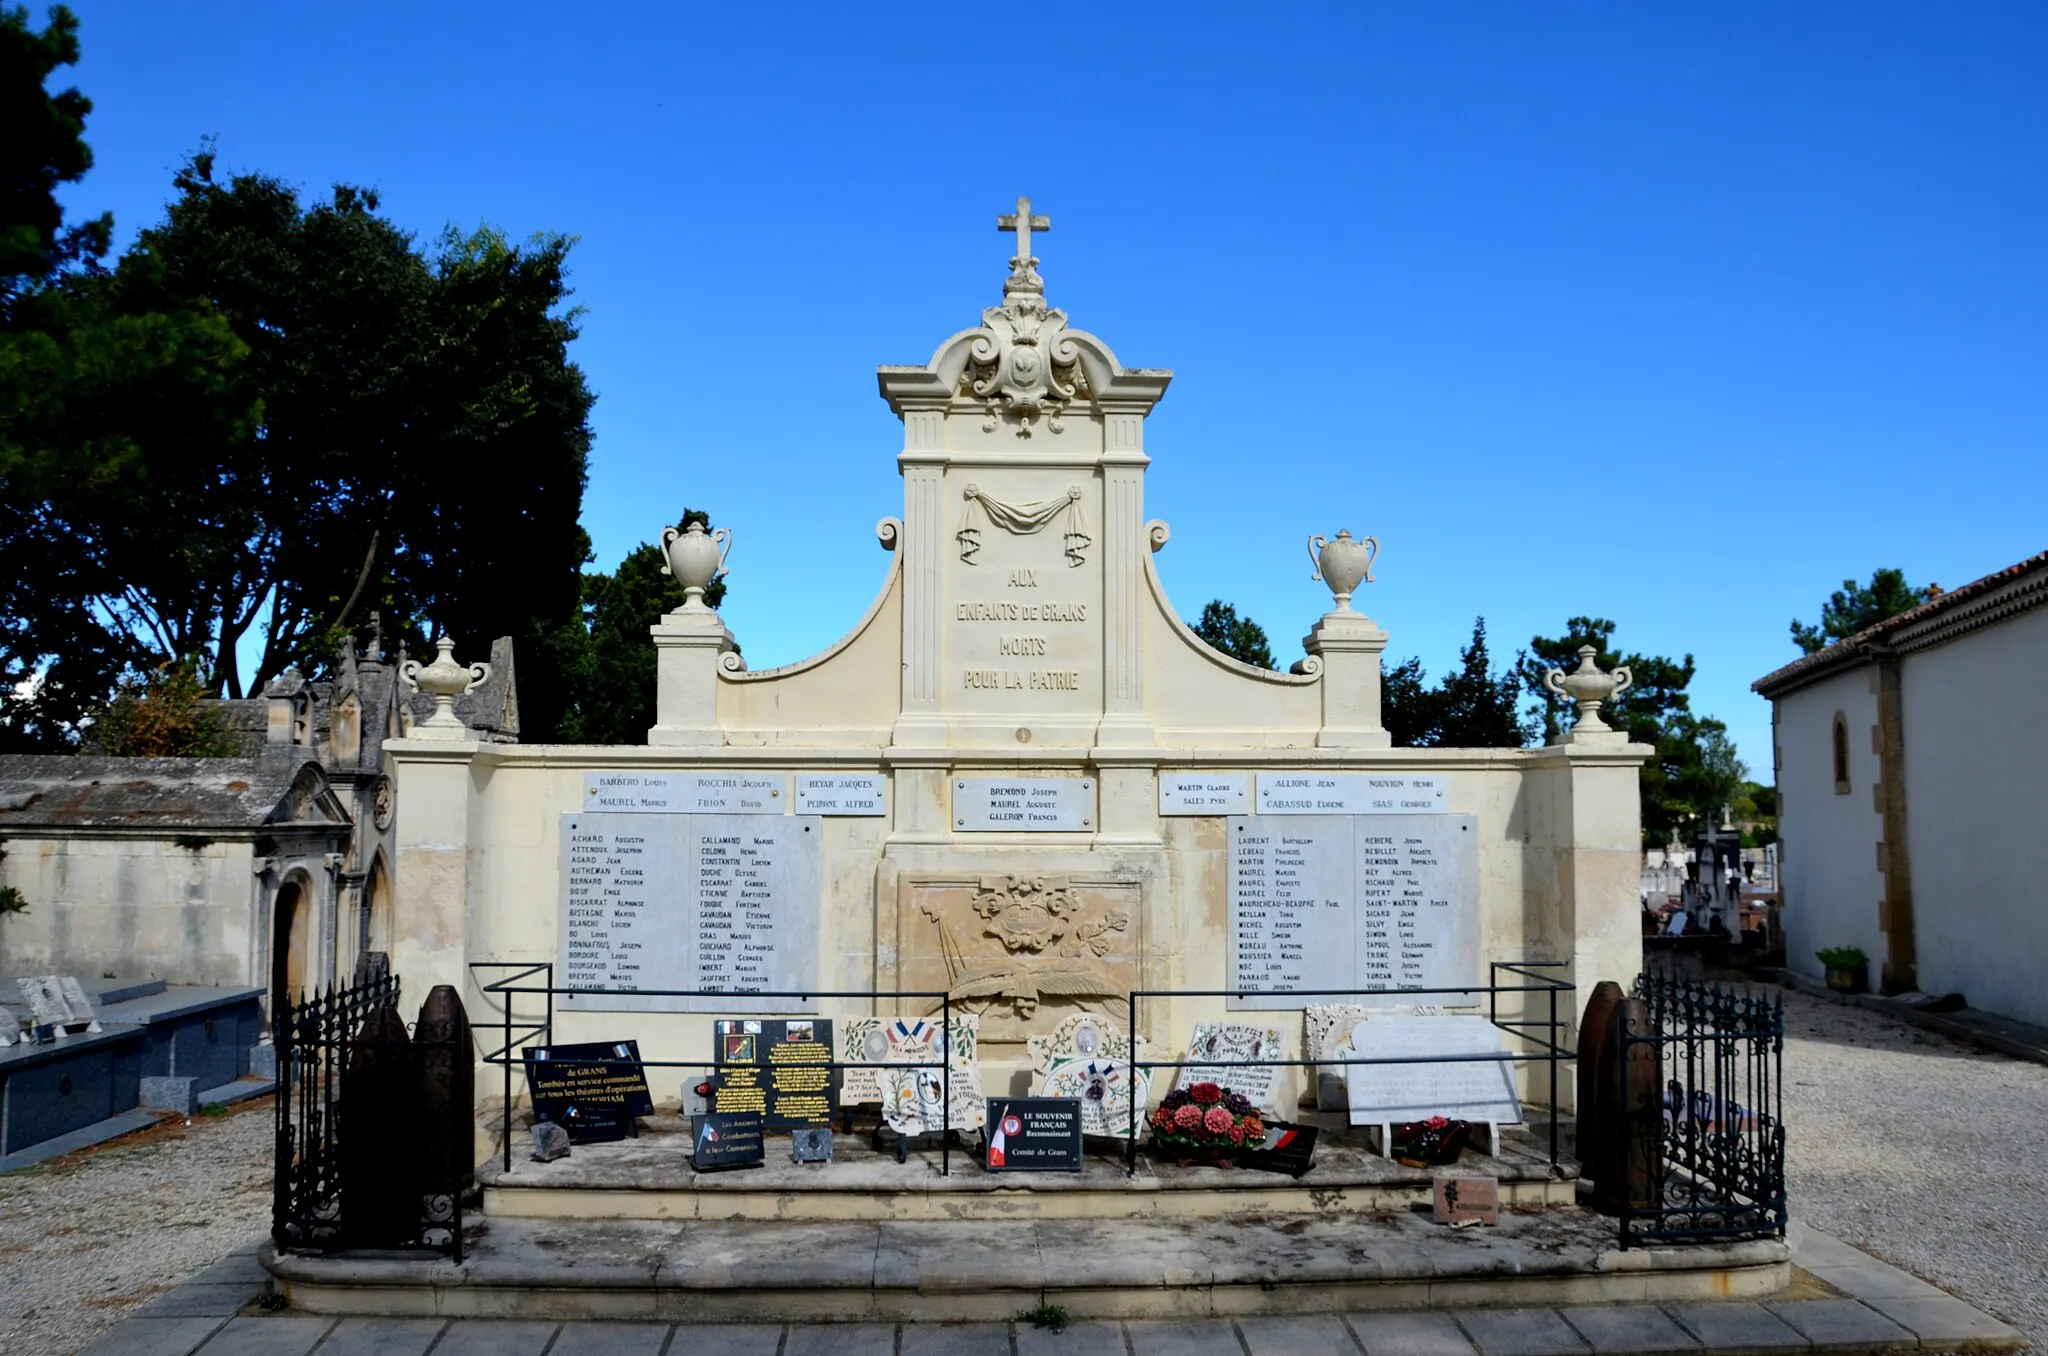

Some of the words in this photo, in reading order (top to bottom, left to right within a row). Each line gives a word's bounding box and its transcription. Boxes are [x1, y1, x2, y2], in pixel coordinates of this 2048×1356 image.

[1008, 569, 1038, 588] AUX
[956, 602, 1018, 622] ENFANTS
[999, 637, 1046, 656] MORTS
[964, 671, 998, 689] POUR
[1005, 671, 1023, 689] LA
[1029, 671, 1079, 689] PATRIE
[577, 1067, 608, 1076] GRANS
[577, 1076, 602, 1085] service
[1024, 1112, 1033, 1120] LE
[1035, 1112, 1073, 1120] SOUVENIR
[1030, 1121, 1067, 1130] FRANÇAIS
[1037, 1148, 1046, 1156] de
